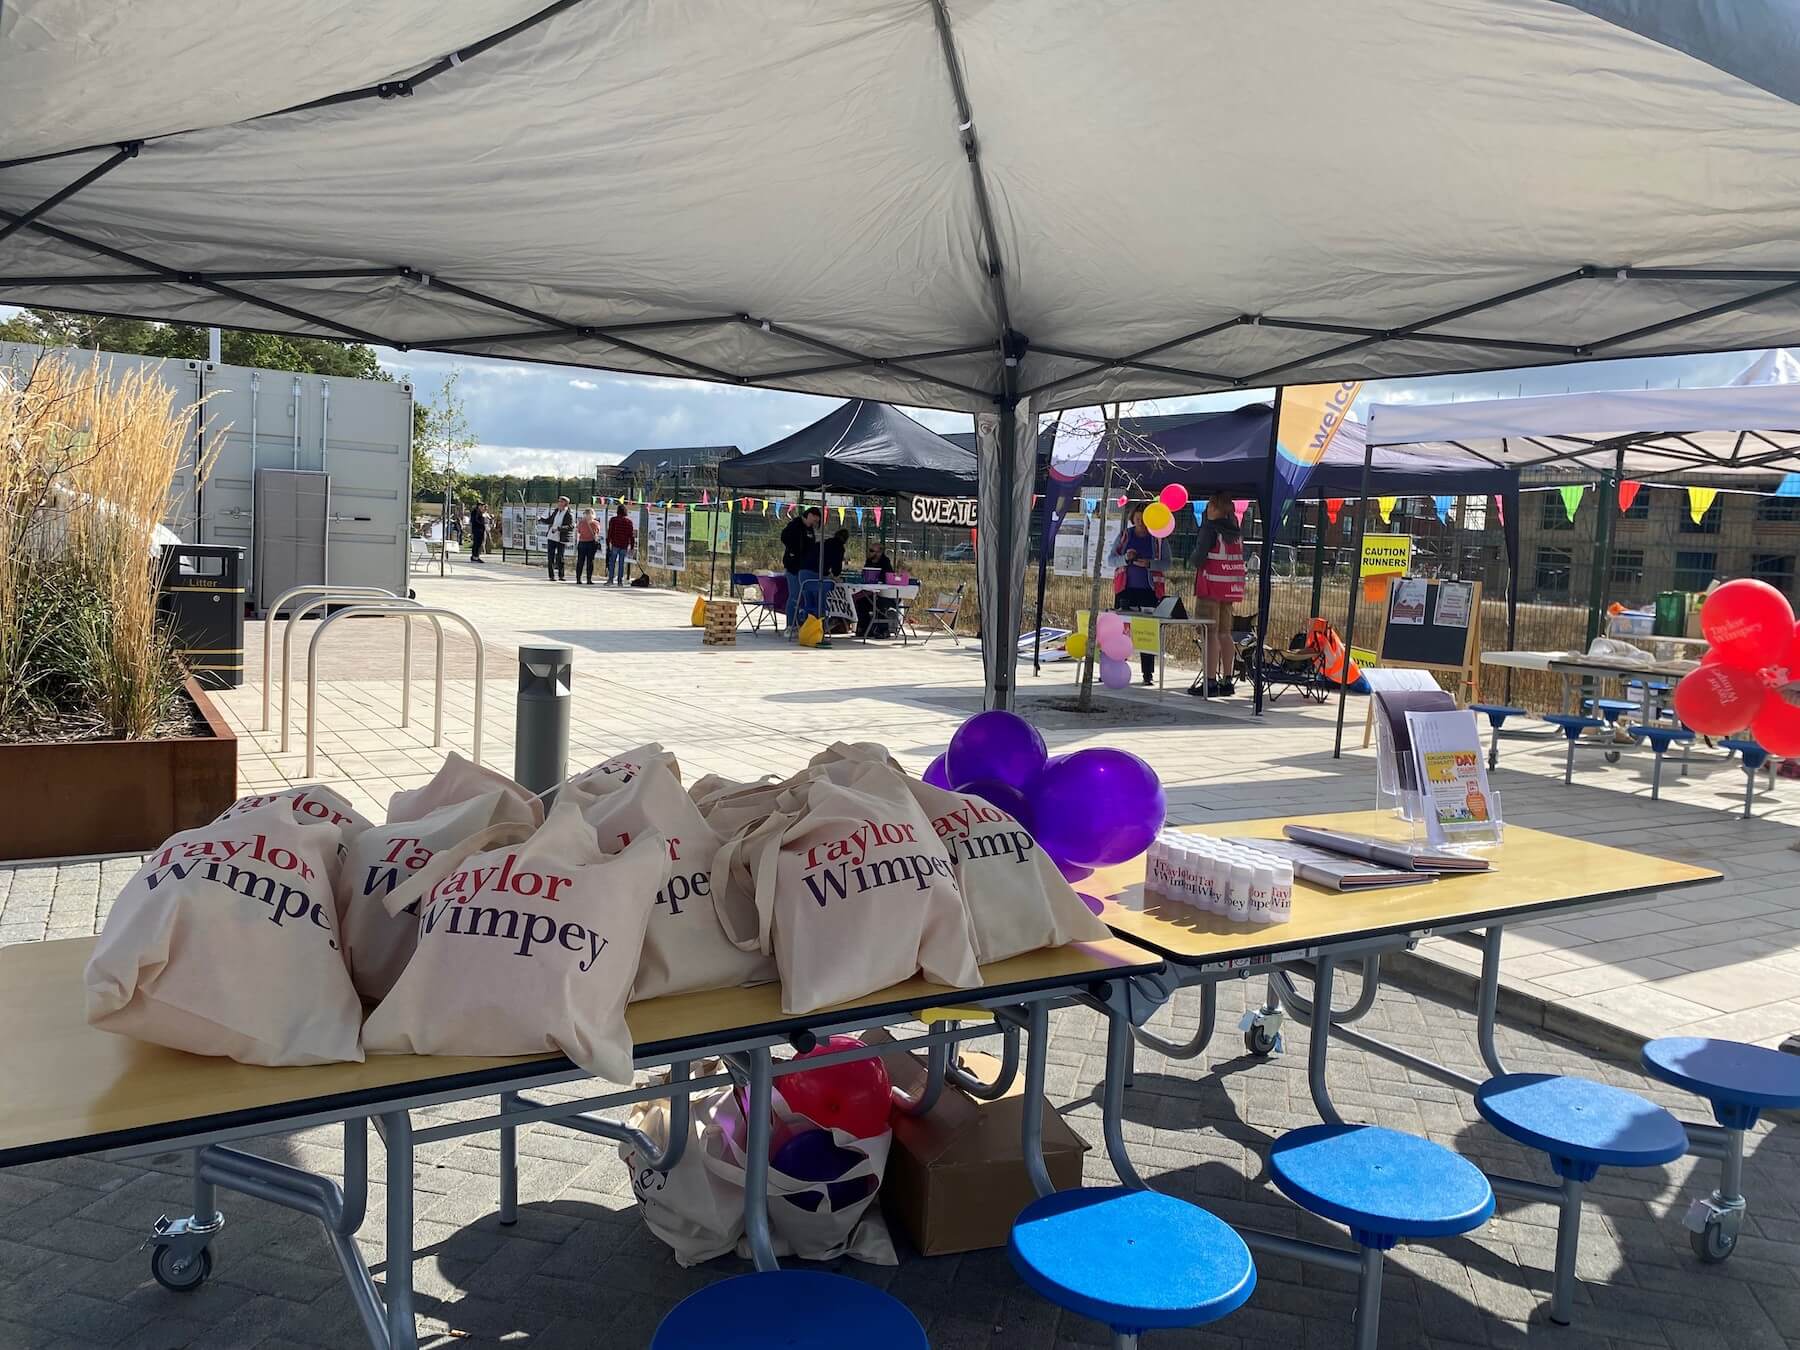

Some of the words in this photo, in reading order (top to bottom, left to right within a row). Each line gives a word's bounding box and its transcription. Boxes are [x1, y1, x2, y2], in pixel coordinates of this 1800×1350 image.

[1364, 547, 1406, 556] CAUTION
[1362, 557, 1407, 567] RUNNERS
[1454, 754, 1477, 766] DAY
[151, 834, 316, 880] Taylor
